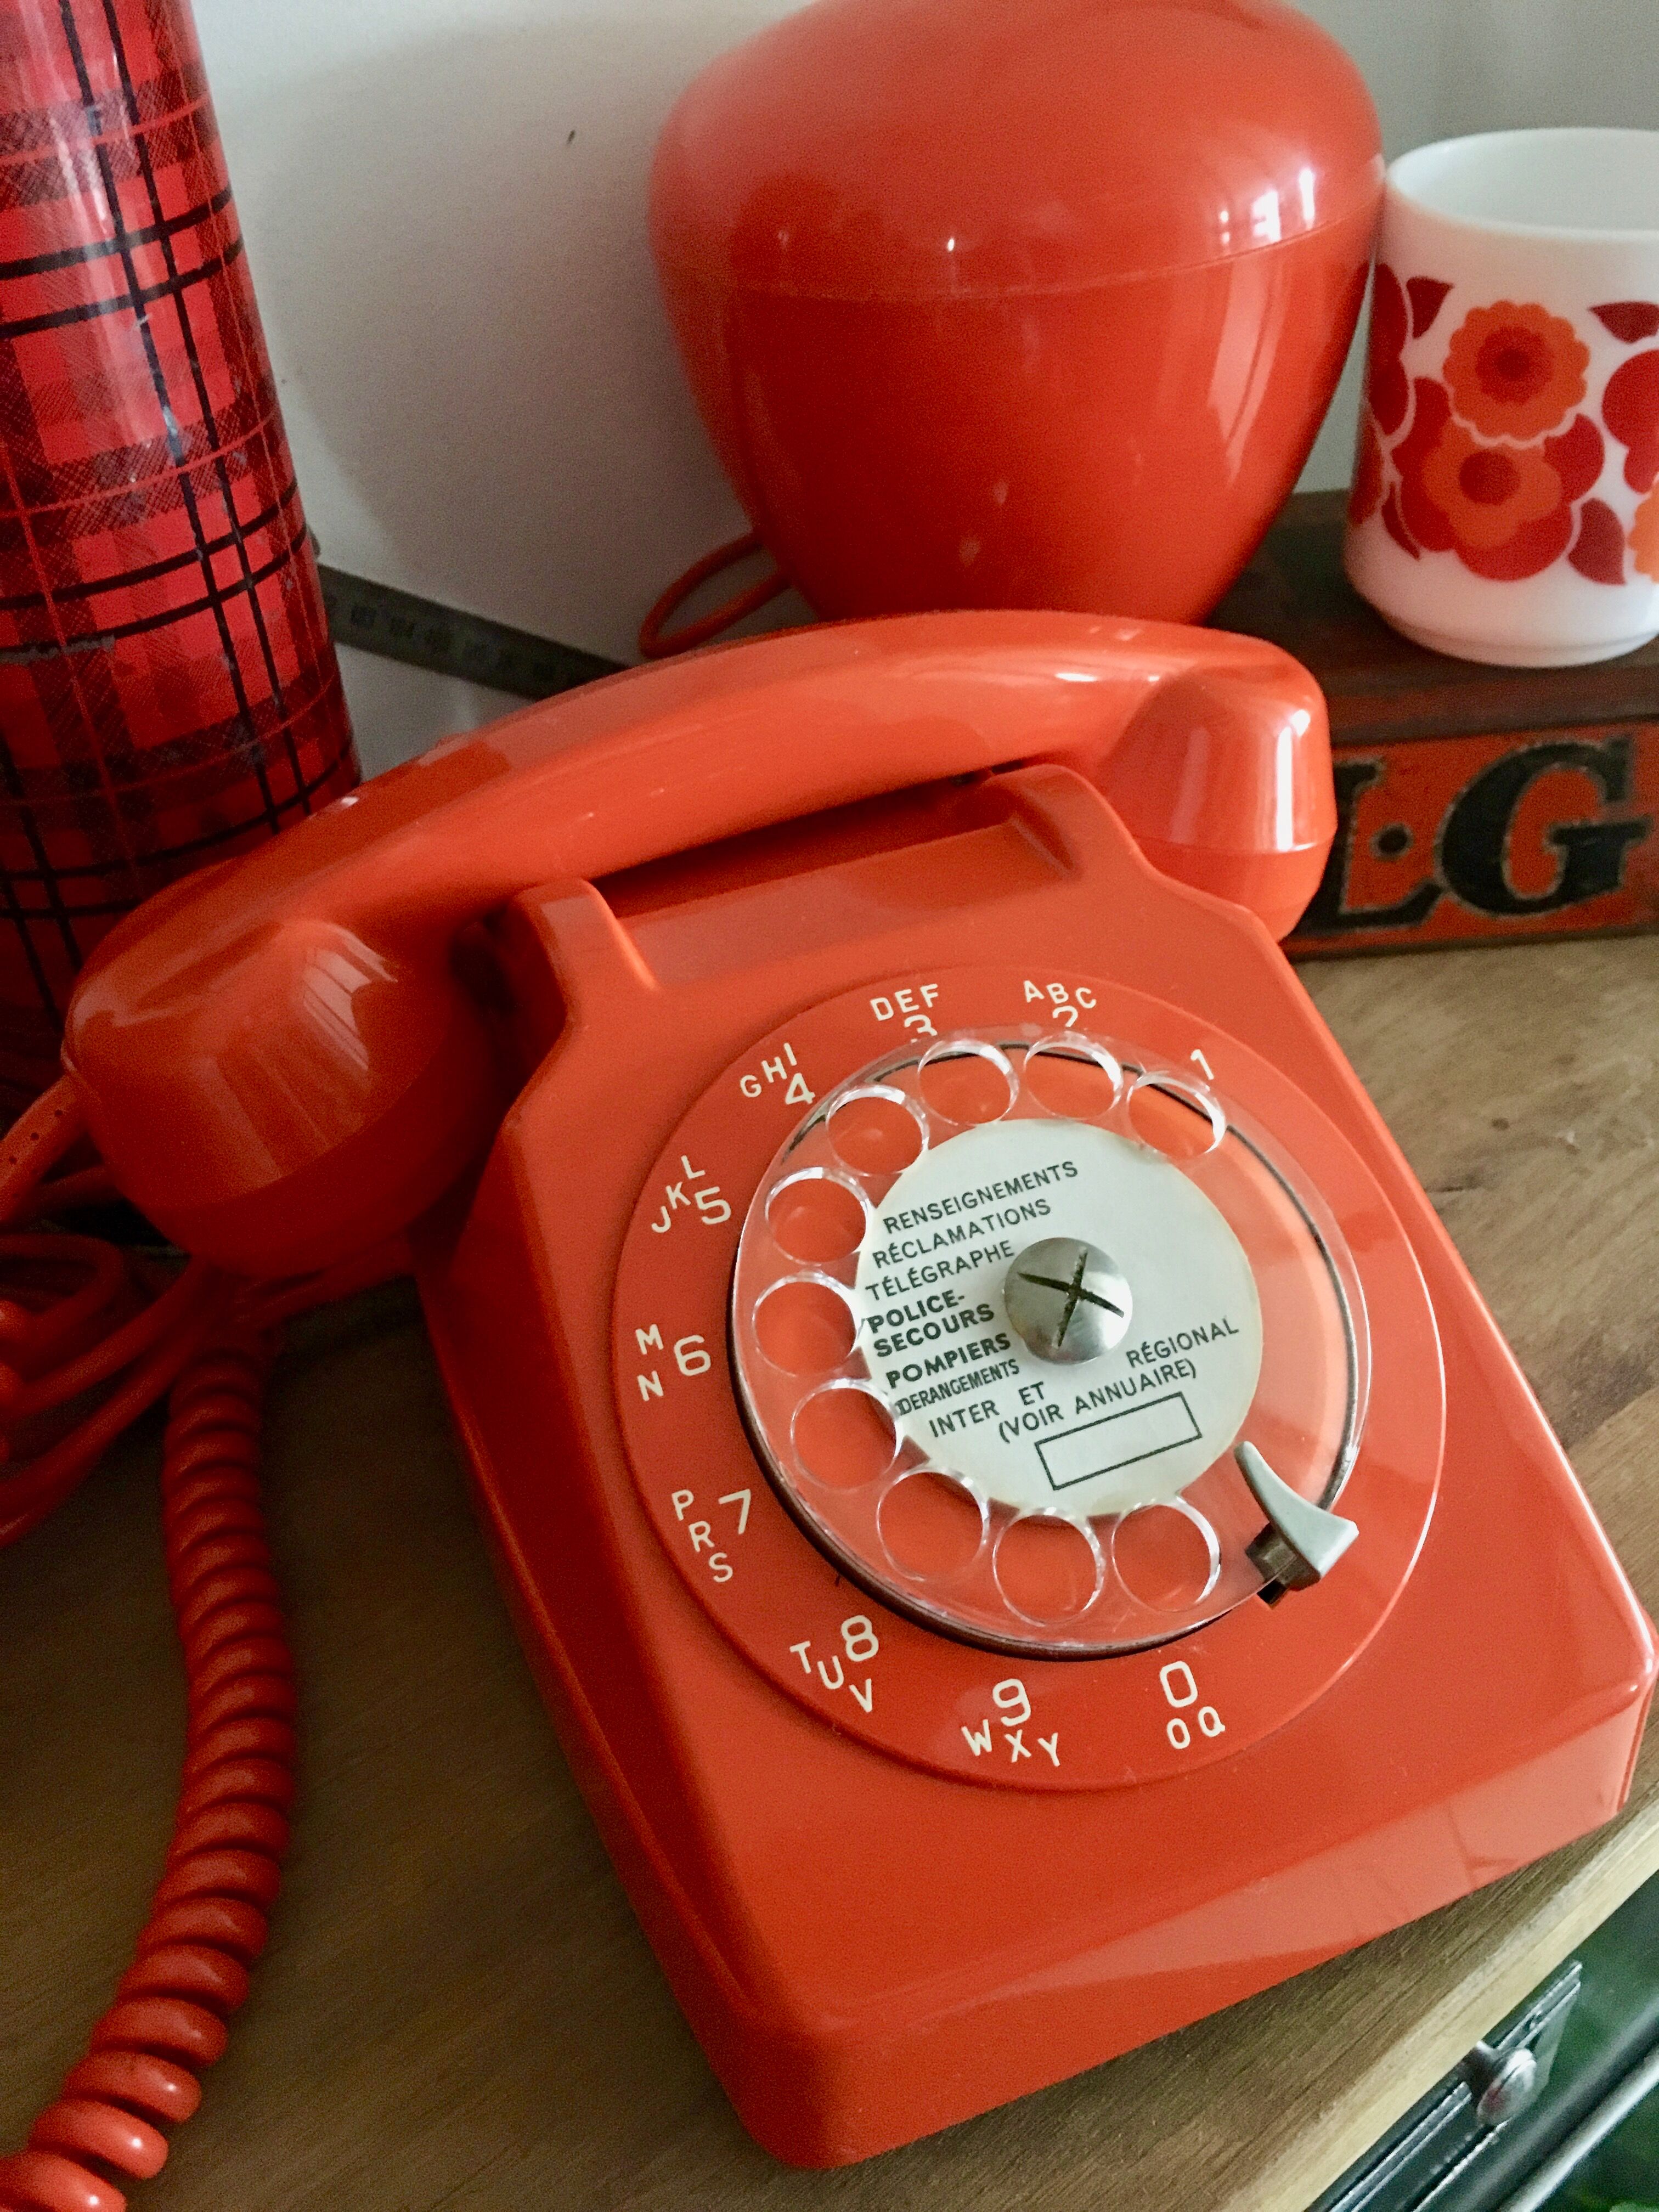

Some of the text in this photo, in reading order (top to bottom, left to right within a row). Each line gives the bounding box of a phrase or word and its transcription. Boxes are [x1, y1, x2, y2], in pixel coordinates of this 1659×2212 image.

[870, 983, 939, 1022] DEF
[1023, 979, 1097, 1009] ABC
[739, 1042, 798, 1098] GHI
[785, 1072, 816, 1105] 4
[1190, 1048, 1215, 1081] 1
[651, 1154, 706, 1234] JKL
[695, 1186, 732, 1225] 5
[882, 1160, 1079, 1234] RENSEIGNEMENTS
[872, 1197, 1052, 1269] RÉCLAMATIONS
[865, 1239, 1015, 1301] TÉLÉGRAPHE
[865, 1289, 966, 1334] POLICE-
[873, 1303, 995, 1358] SECOURS
[673, 1334, 712, 1376] 6
[885, 1332, 1011, 1389] POMPIERS
[928, 1317, 1240, 1438] INTER ET RÉGIONAL
[998, 1357, 1197, 1444] (VOIR ANNUAIRE)
[671, 1488, 733, 1583] PRS
[718, 1488, 752, 1535] 7
[840, 1614, 879, 1662] 8
[789, 1640, 873, 1713] TUV
[1159, 1660, 1199, 1708] 0
[992, 1678, 1032, 1727] 9
[961, 1718, 1060, 1767] WXY
